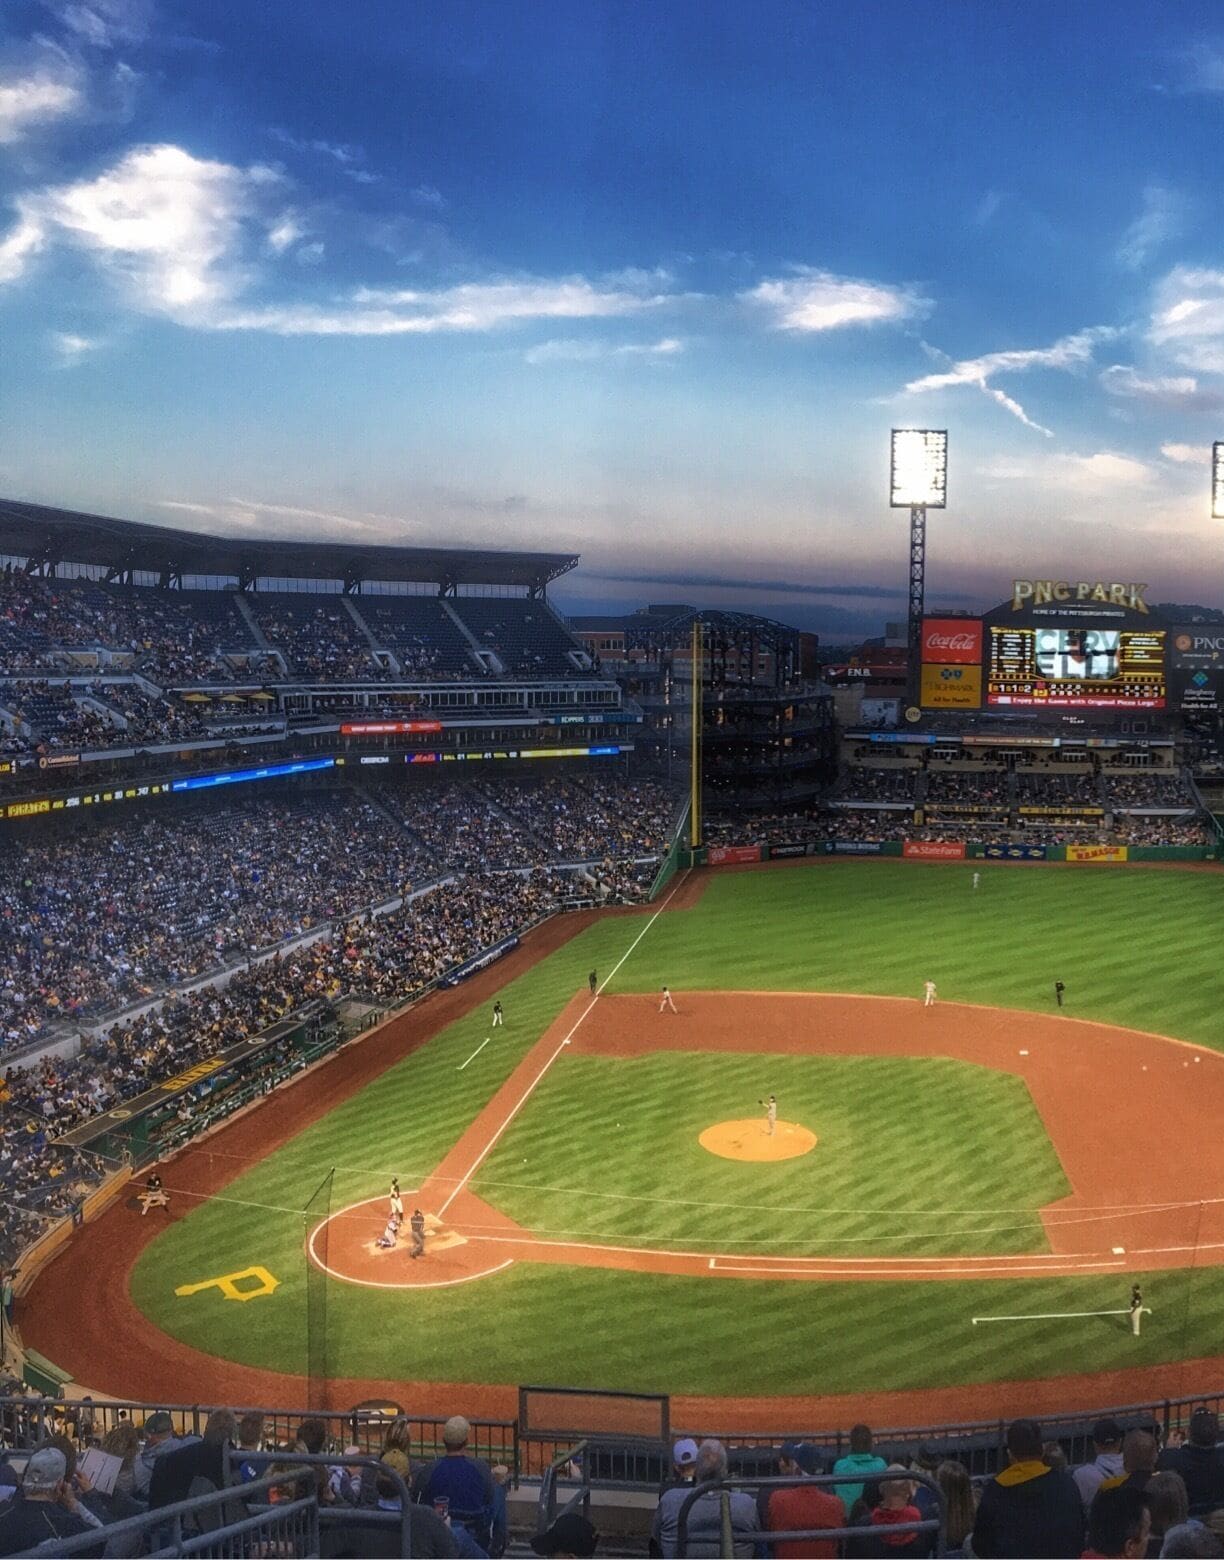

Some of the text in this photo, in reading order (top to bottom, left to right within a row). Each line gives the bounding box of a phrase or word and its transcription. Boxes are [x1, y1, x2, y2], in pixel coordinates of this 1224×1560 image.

[1011, 579, 1150, 615] PNC PARK
[174, 1266, 282, 1302] P
